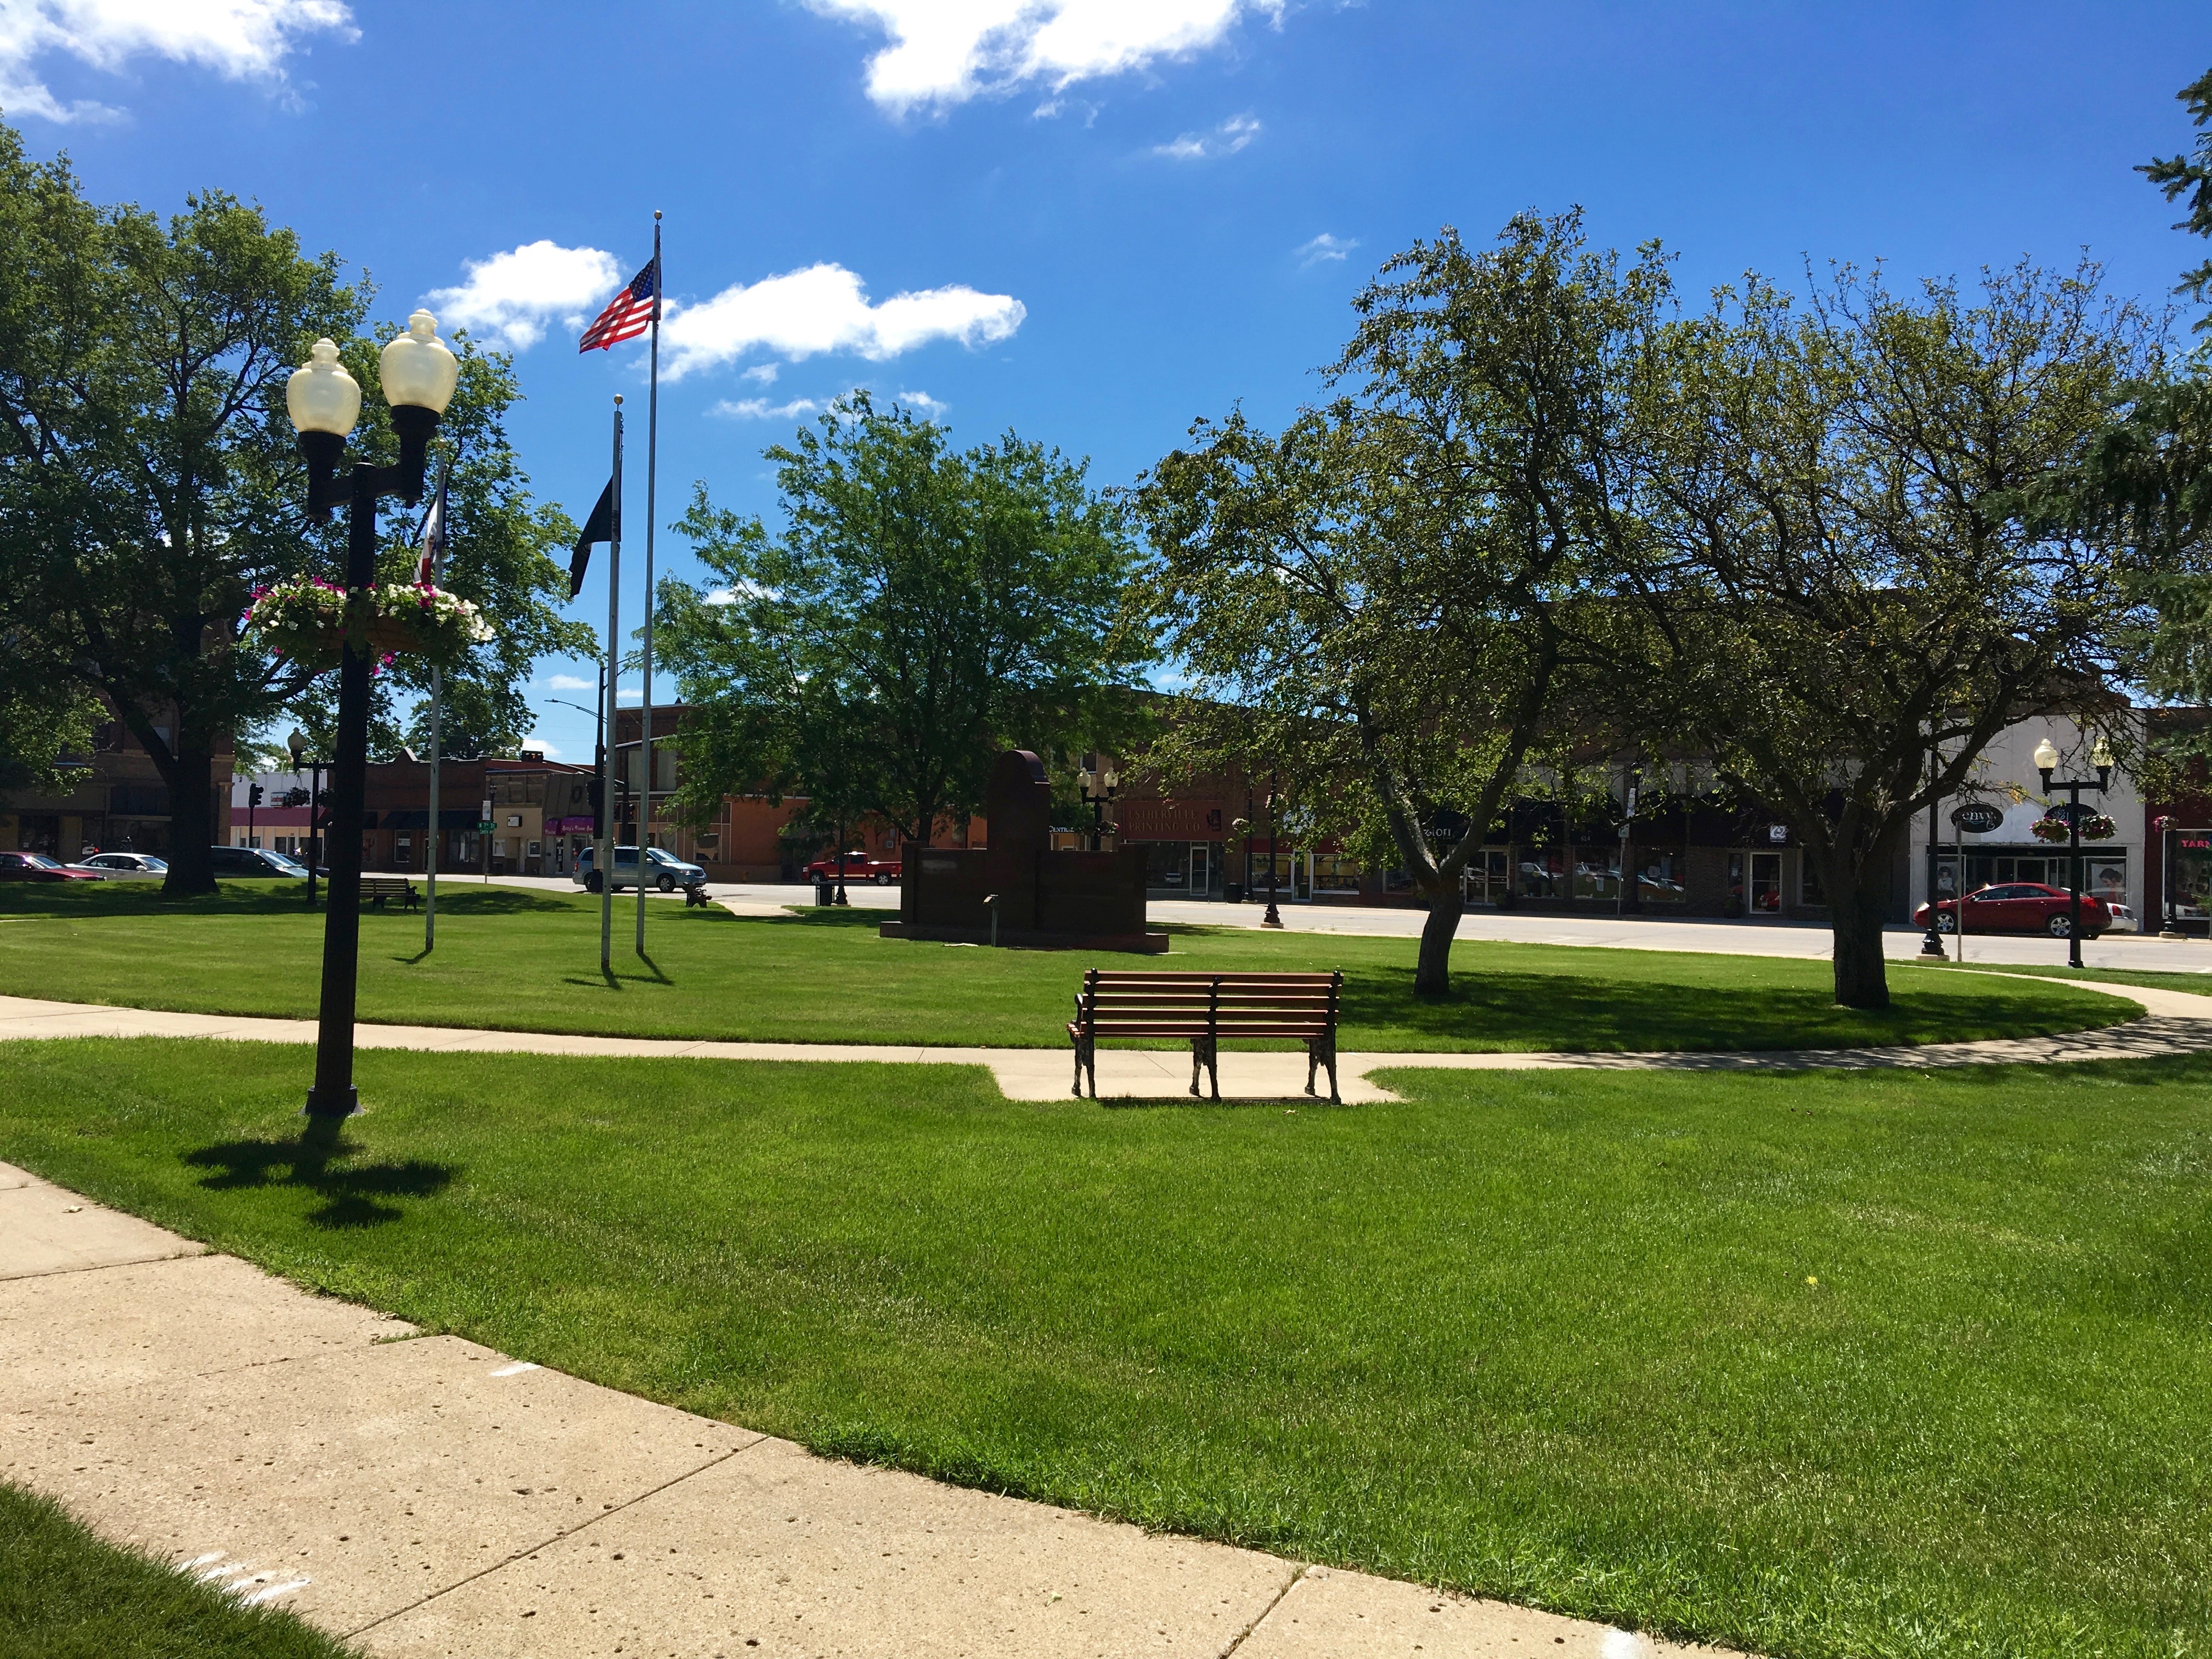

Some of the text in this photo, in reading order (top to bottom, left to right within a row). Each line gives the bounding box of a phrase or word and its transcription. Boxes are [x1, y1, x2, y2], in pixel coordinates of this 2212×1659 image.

[1129, 809, 1197, 819] ESTHERVILLE
[1962, 811, 1995, 830] envy
[1129, 822, 1179, 832] PRINTING
